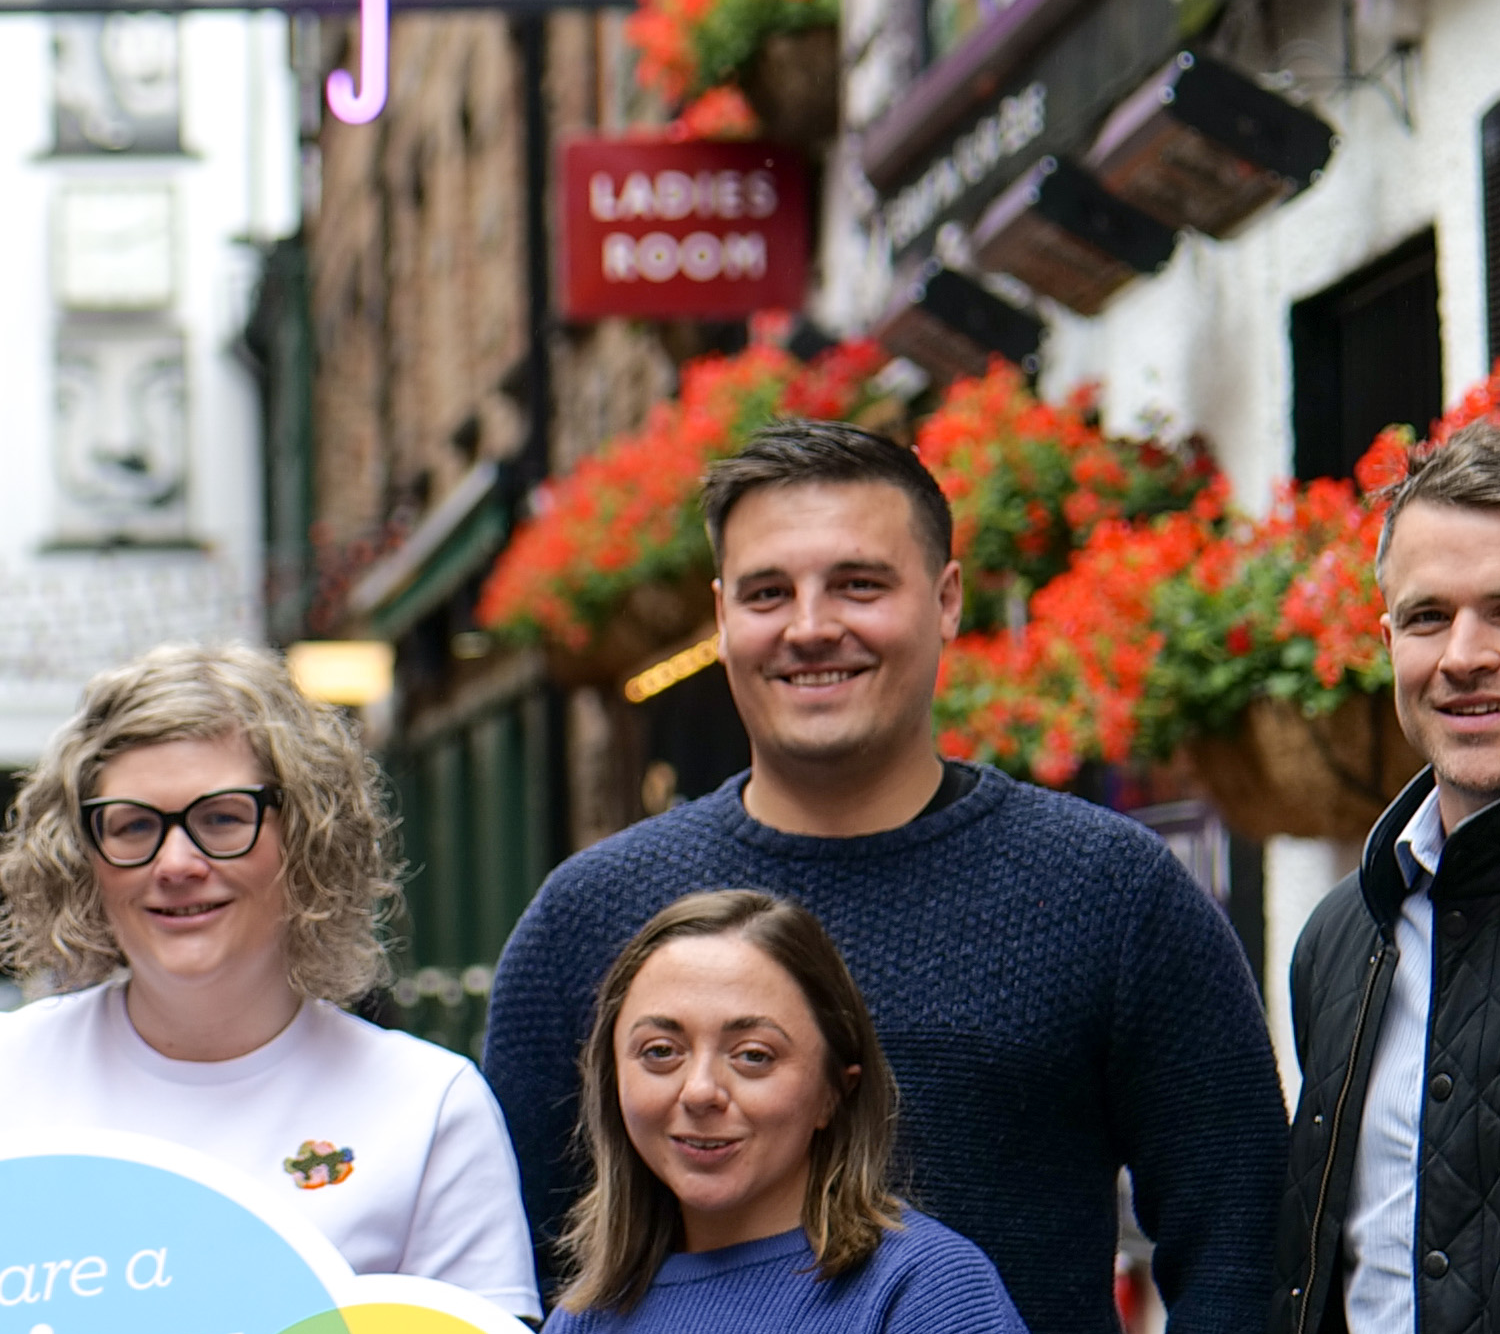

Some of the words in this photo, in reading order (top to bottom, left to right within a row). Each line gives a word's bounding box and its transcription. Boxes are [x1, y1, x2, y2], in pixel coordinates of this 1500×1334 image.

[588, 169, 779, 222] LADIES
[601, 229, 769, 283] ROOM
[124, 1244, 174, 1290] a
